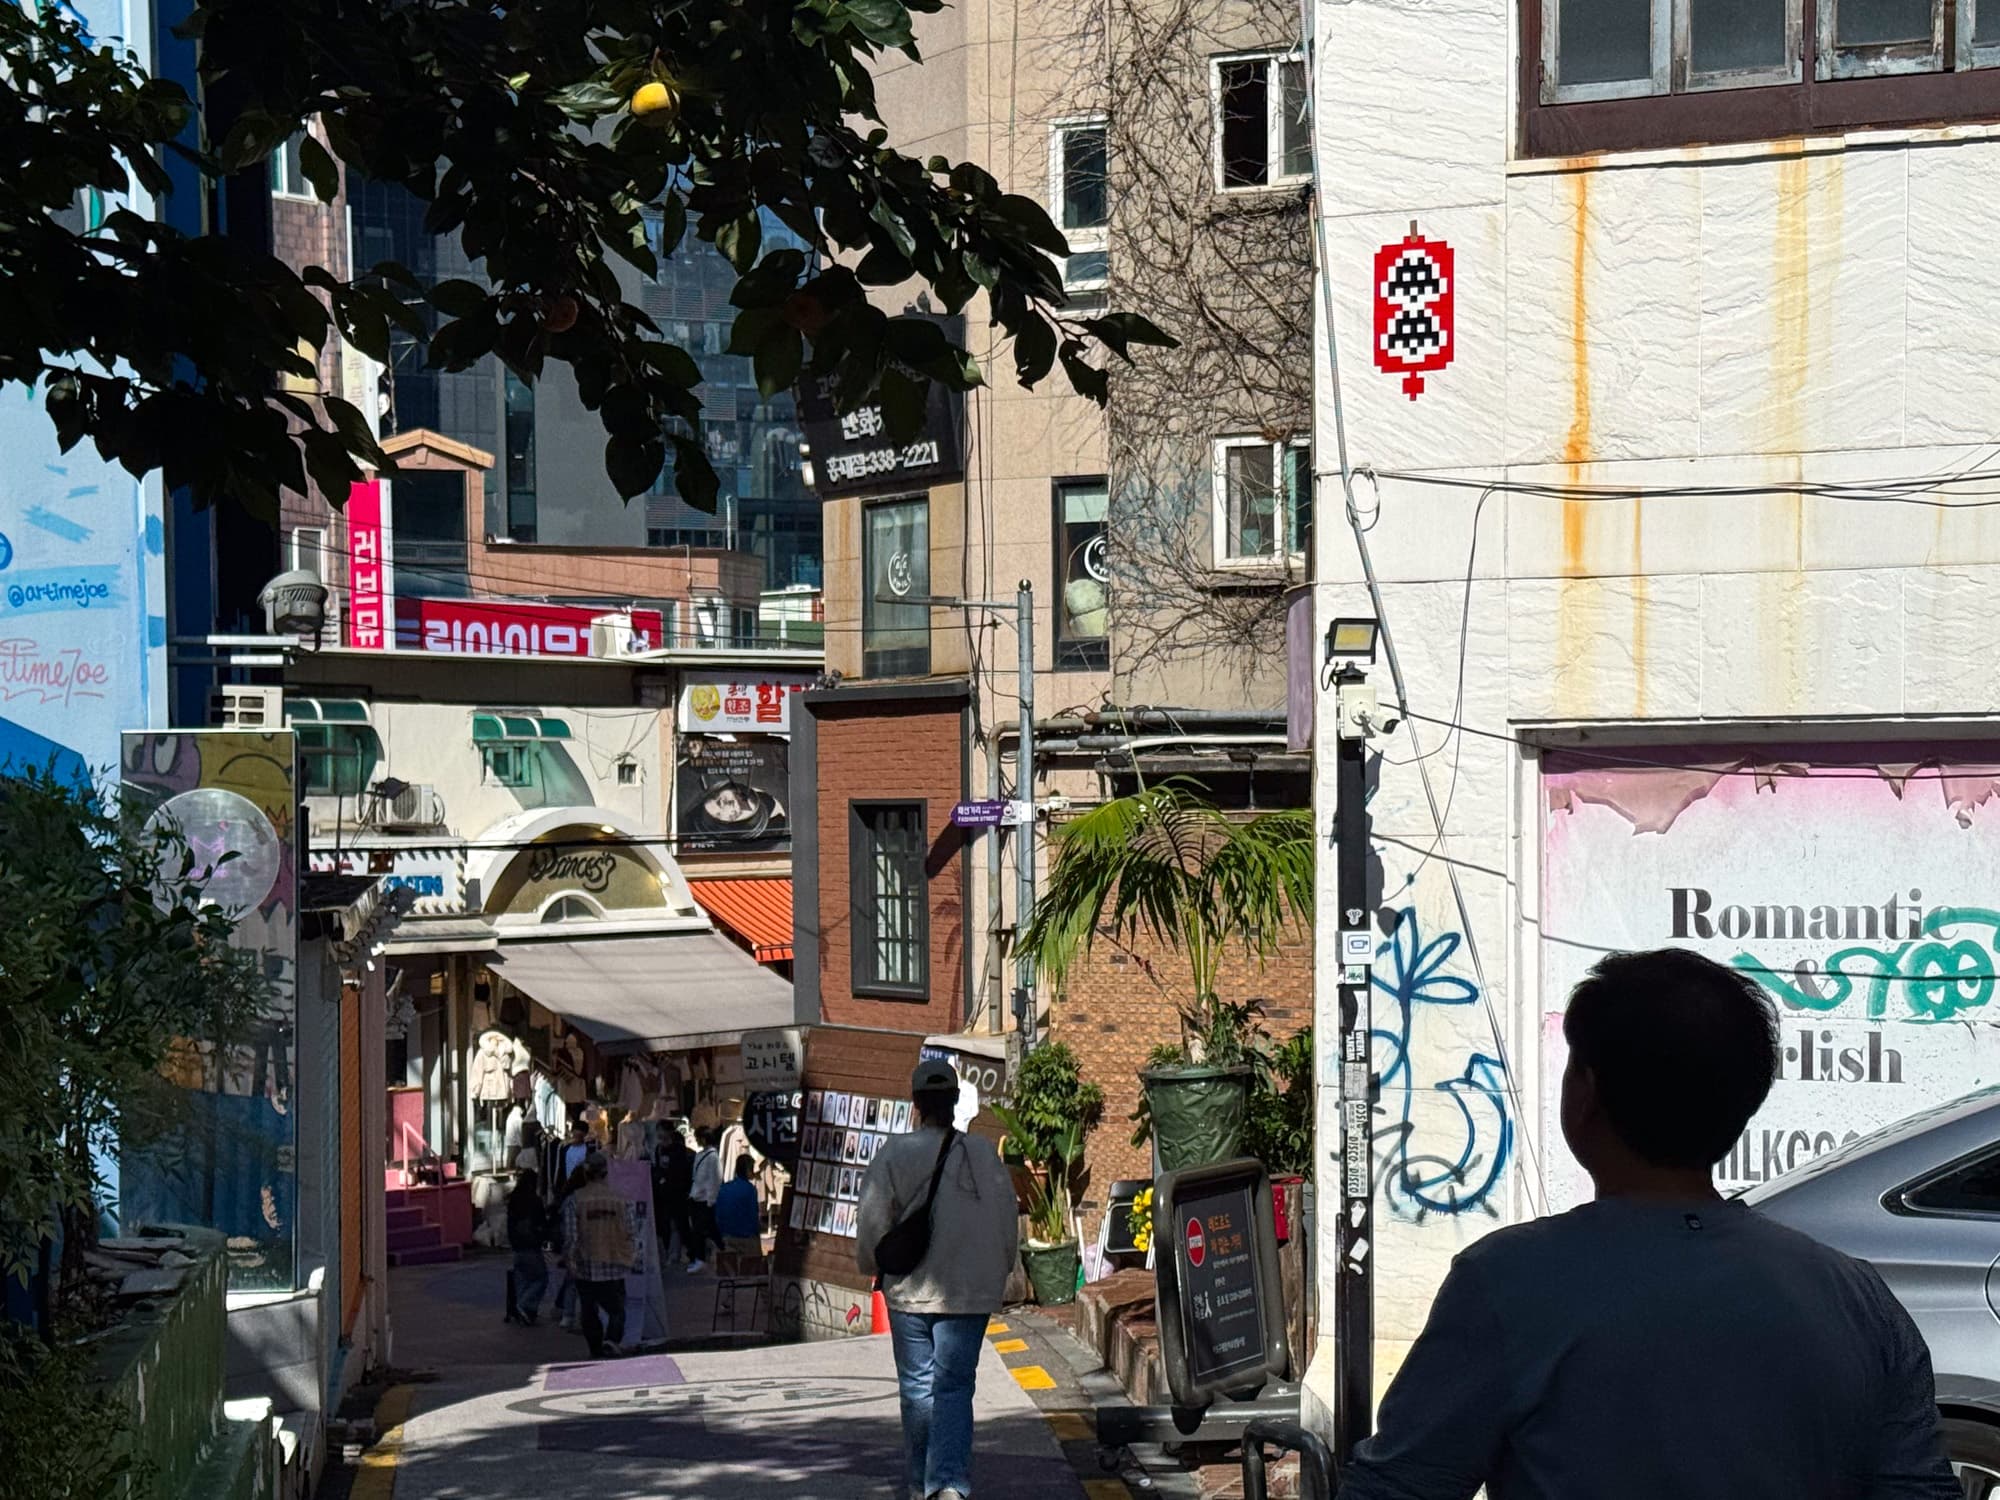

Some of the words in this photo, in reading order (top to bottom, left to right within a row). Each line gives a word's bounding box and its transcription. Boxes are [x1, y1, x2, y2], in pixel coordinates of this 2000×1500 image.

[8, 578, 109, 608] @artimejoe
[1665, 887, 1959, 941] Romantic
[745, 1053, 795, 1072] 고시텔
[1776, 1029, 1906, 1084] rlish
[1718, 1128, 1861, 1182] ILKCO
